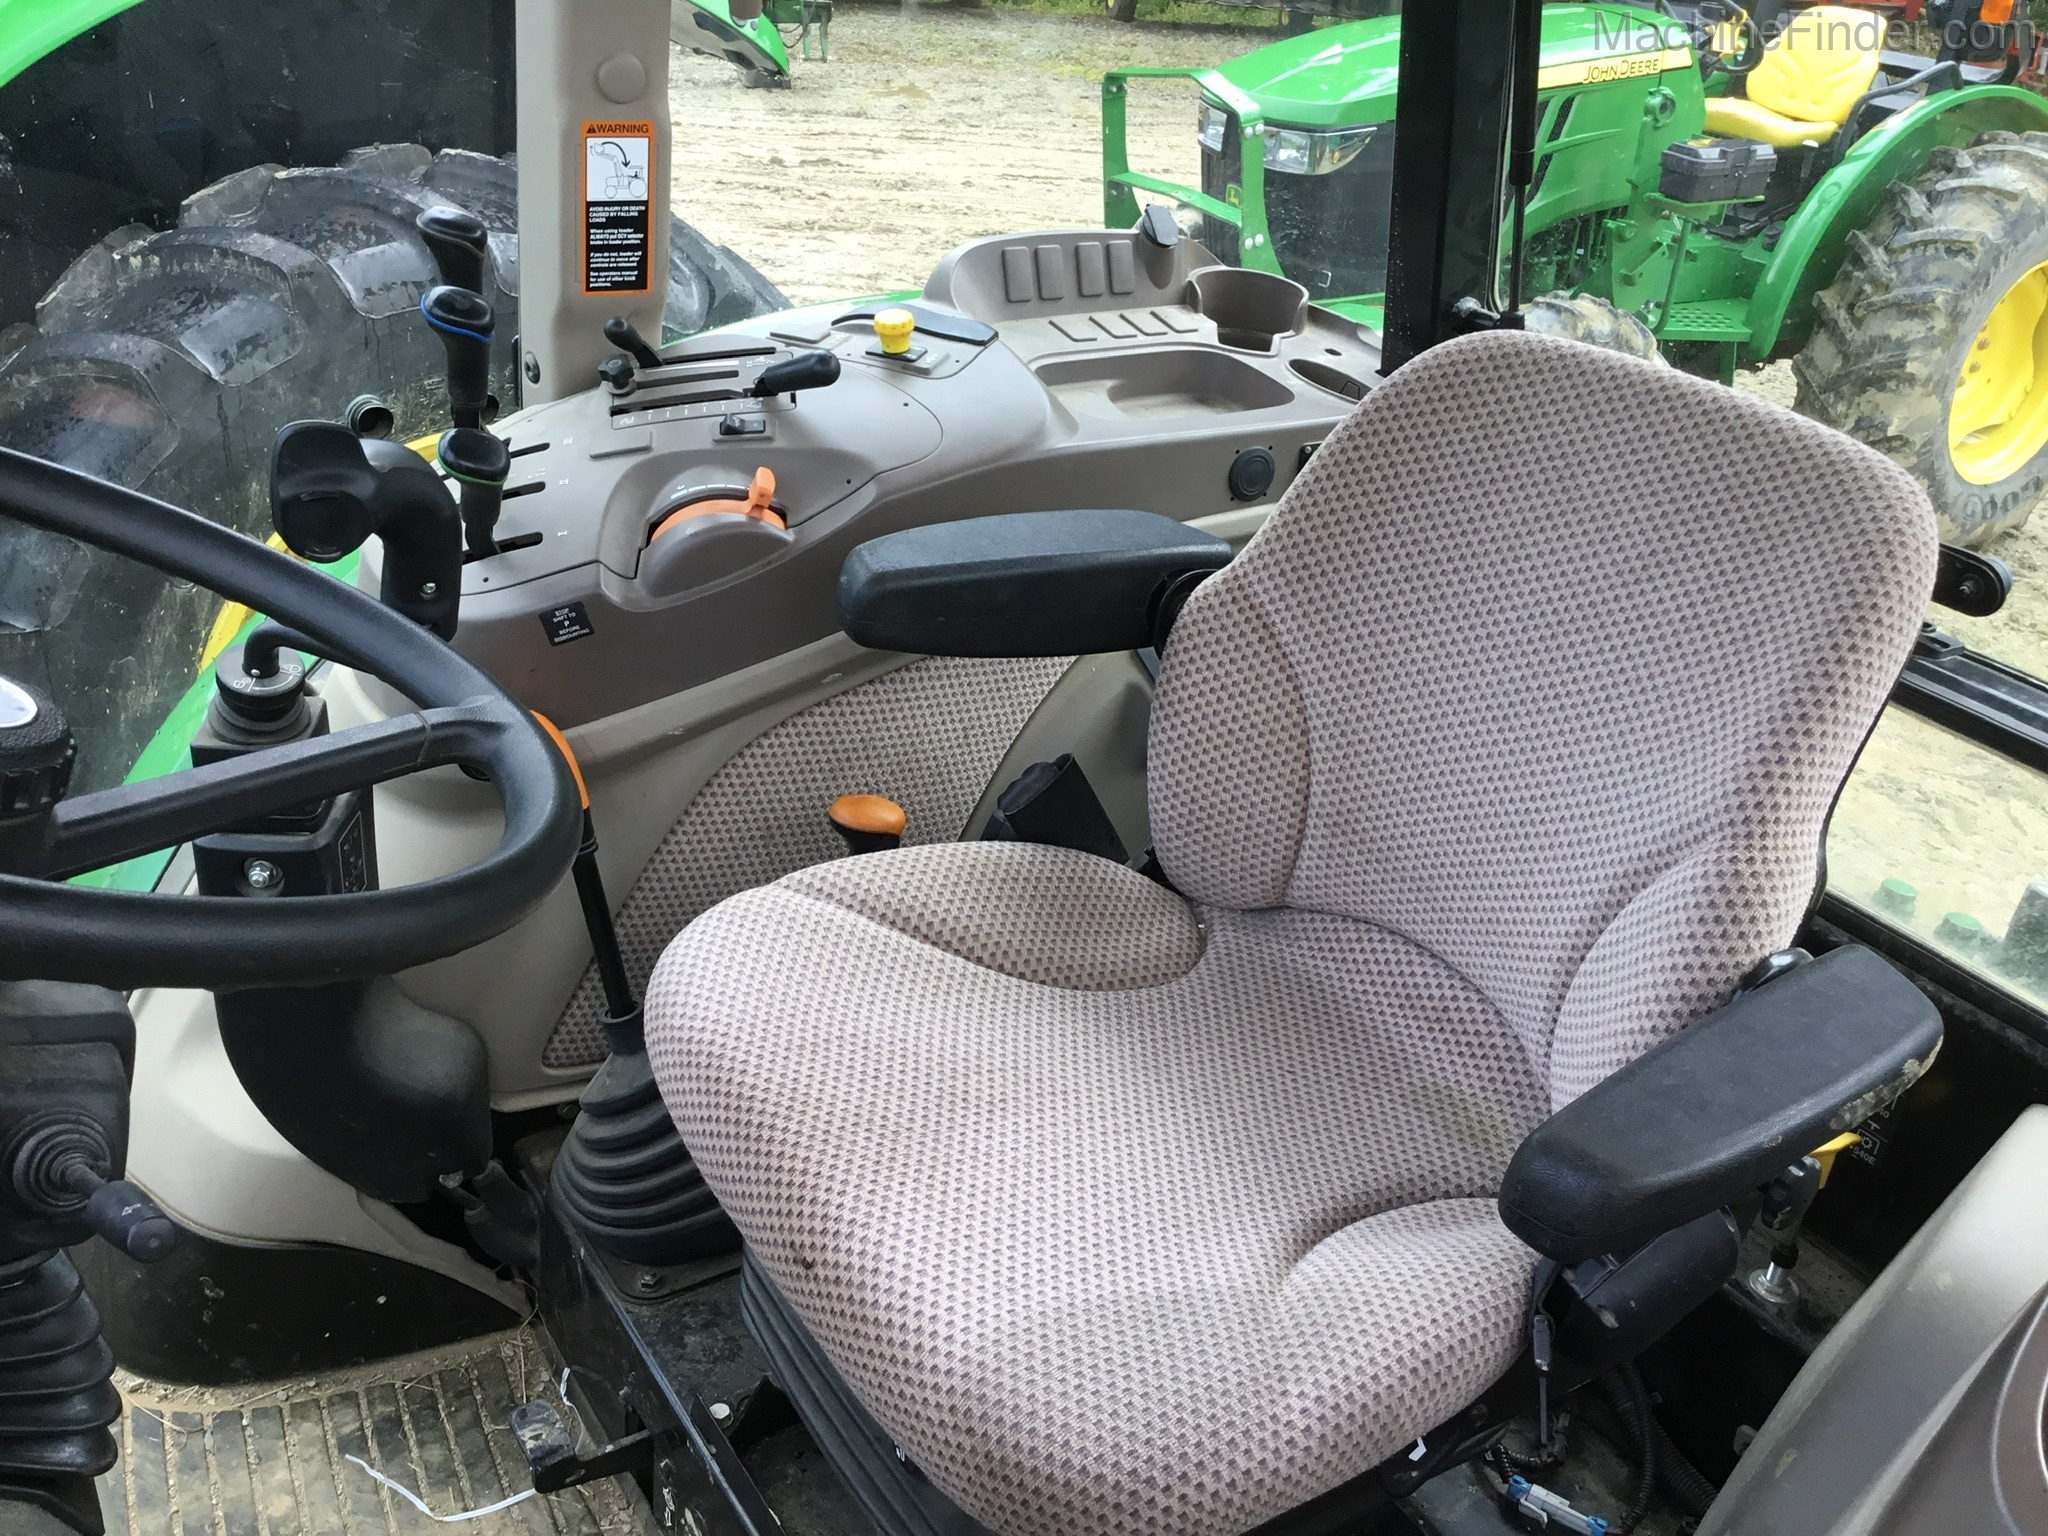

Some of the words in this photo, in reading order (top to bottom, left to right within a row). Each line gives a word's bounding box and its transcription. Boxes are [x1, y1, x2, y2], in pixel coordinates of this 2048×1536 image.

[1583, 64, 1618, 82] JOHN
[1620, 59, 1660, 76] DEERE
[596, 124, 649, 134] WARNING
[555, 608, 569, 616] STOP
[559, 624, 580, 635] BEFORE
[554, 628, 590, 643] DISMOUNTING
